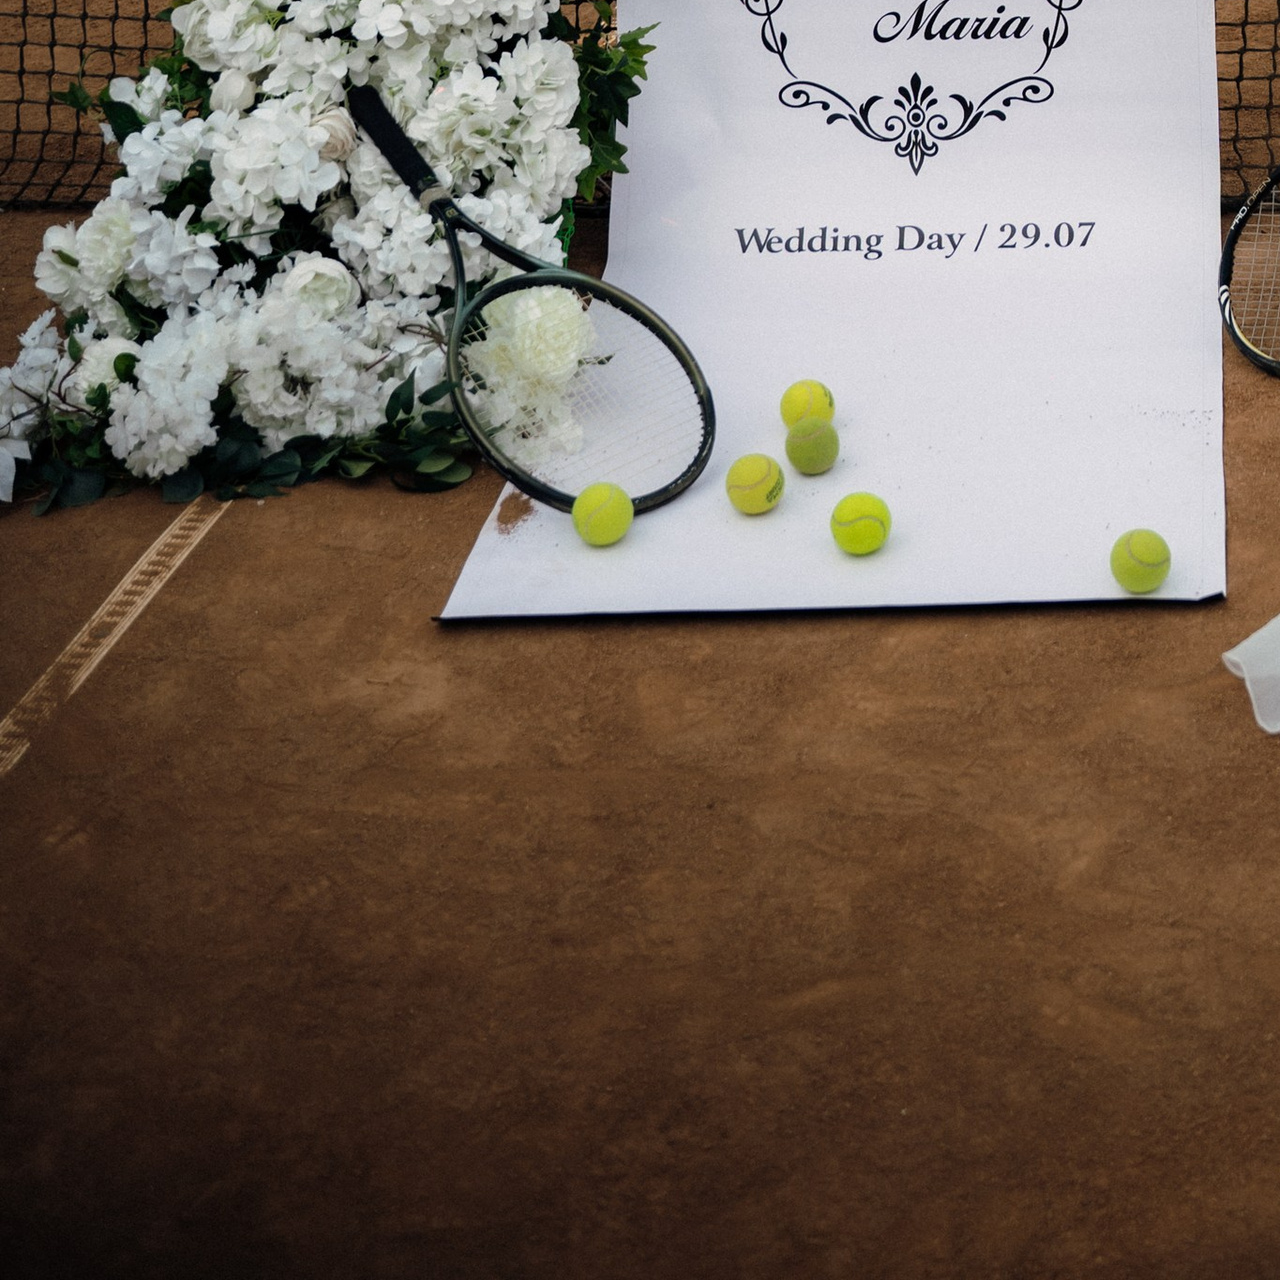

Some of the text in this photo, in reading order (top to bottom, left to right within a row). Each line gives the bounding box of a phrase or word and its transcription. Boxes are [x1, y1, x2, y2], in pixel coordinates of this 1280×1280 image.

[734, 222, 1096, 260] Wedding Day / 29.07
